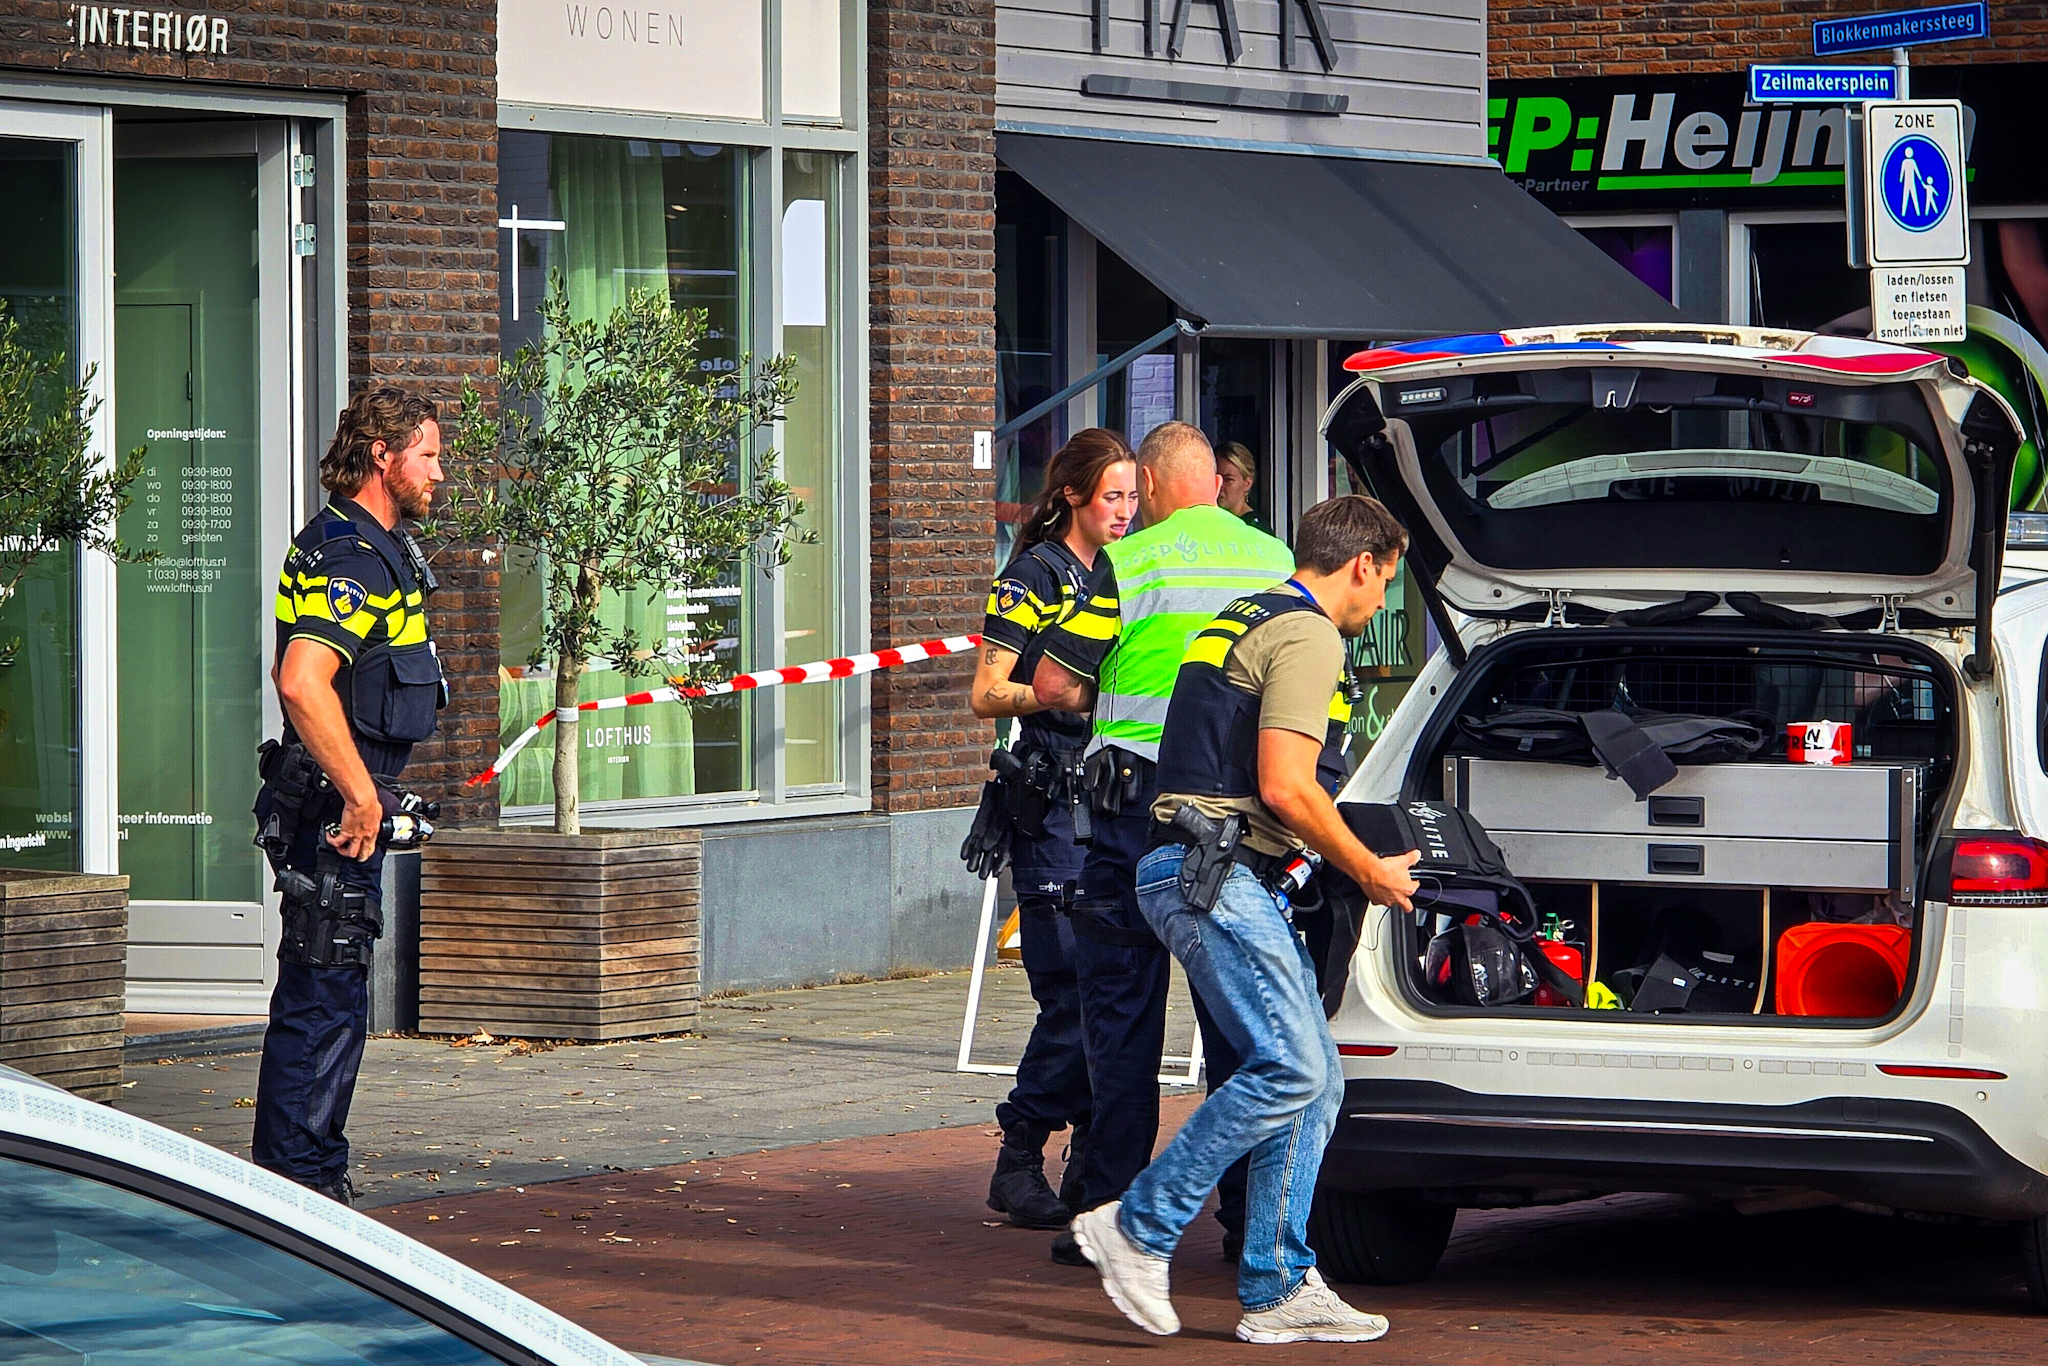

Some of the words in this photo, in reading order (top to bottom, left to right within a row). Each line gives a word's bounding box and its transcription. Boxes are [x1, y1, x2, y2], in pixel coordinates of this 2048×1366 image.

[79, 6, 229, 54] INTERIØR
[566, 3, 684, 46] WONEN
[1822, 13, 1975, 44] Blokkenmakerssteeg
[1761, 73, 1889, 95] Zeilmakersplein
[1895, 114, 1935, 128] ZONE
[1887, 273, 1954, 286] laden/lossen
[1895, 293, 1907, 302] en
[1911, 291, 1948, 302] fietsen
[1944, 325, 1963, 336] niet
[147, 428, 227, 441] Openingstijden:
[980, 437, 985, 463] 1
[147, 467, 156, 477] di
[147, 482, 161, 490] wo
[147, 494, 160, 503] do
[147, 508, 156, 516] vr
[147, 521, 158, 529] za
[147, 534, 158, 542] zo
[182, 532, 223, 545] gesloten
[154, 557, 226, 568] hello@lofthus.nl
[147, 570, 152, 579] T
[154, 568, 179, 581] (033)
[181, 570, 199, 580] 888
[201, 570, 213, 580] 38
[147, 583, 213, 593] www.lofthus.nl
[1351, 609, 1413, 667] AIR
[586, 725, 651, 748] LOFTHUS
[146, 812, 213, 824] informatie
